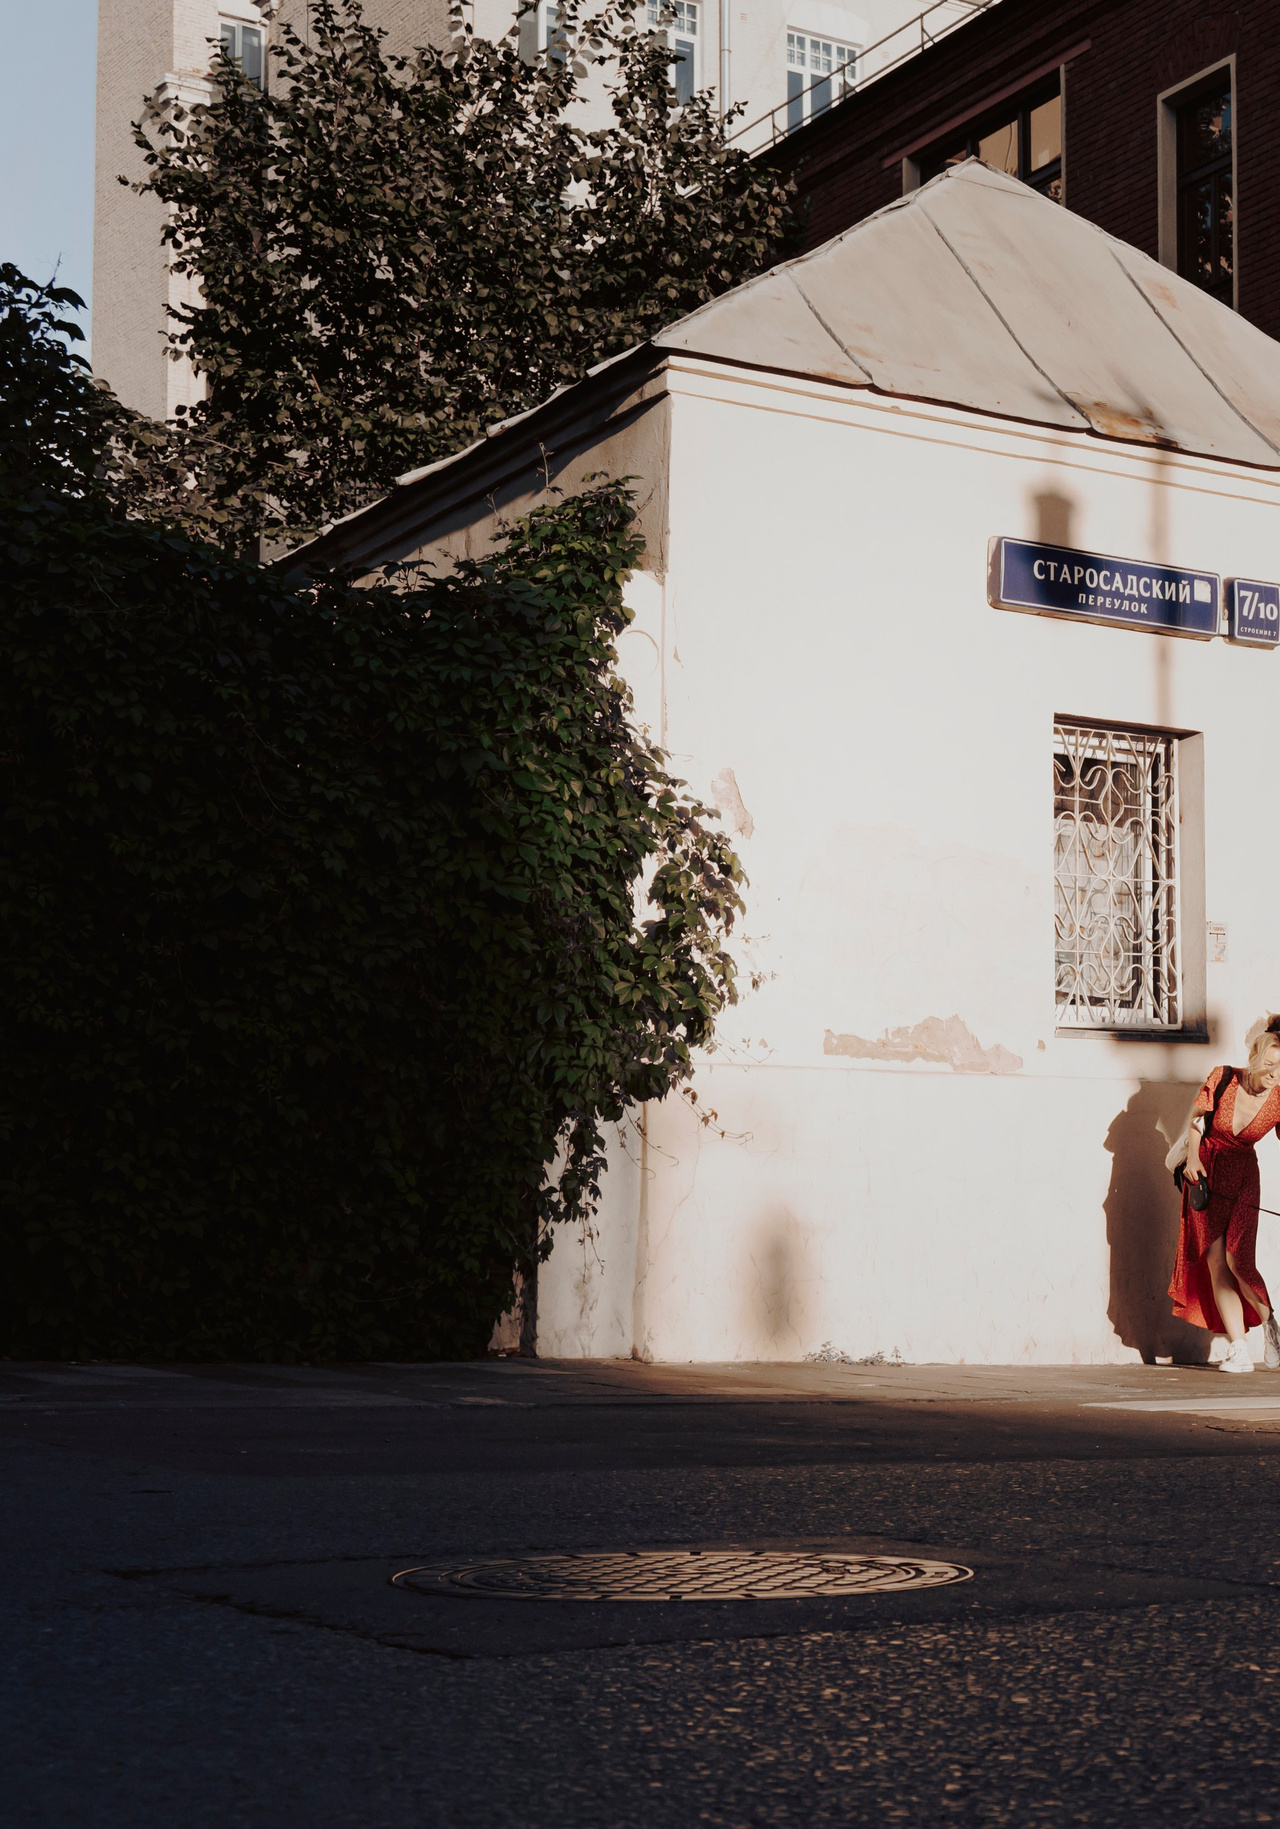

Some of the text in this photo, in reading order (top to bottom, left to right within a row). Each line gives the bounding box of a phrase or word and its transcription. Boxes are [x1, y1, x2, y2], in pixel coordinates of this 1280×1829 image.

[1033, 559, 1191, 604] СТАРОСАДСКИЙ
[1078, 593, 1148, 614] ПЕРЕУЛОК
[1240, 590, 1278, 620] 7/10
[1240, 626, 1271, 636] СТРОЕНИЕ
